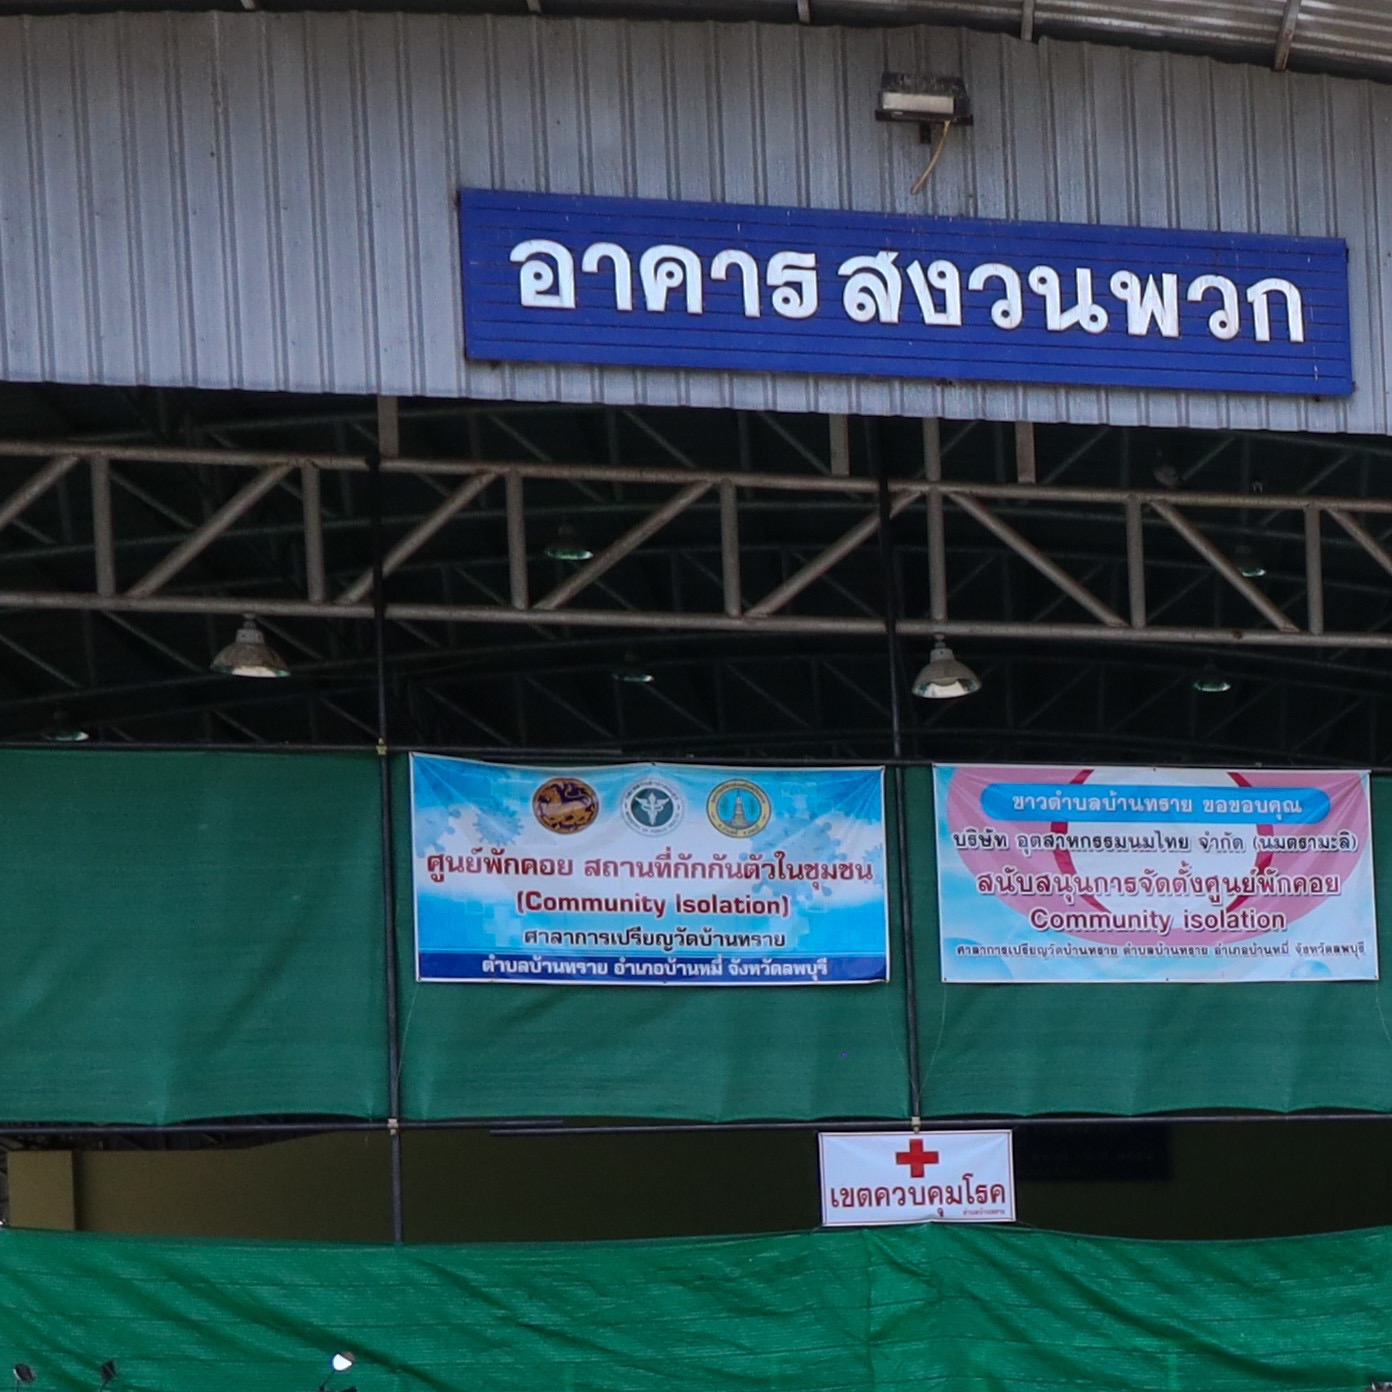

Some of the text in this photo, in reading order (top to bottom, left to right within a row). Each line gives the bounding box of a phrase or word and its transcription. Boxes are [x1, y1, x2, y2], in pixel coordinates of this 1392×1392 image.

[508, 237, 1306, 344] อาคาร สงวนพวก
[1202, 795, 1303, 820] ขอขอบคุณ
[953, 829, 1008, 850] บริษัท
[1017, 830, 1189, 857] อุตสาหกรรมนมไทย
[1197, 832, 1244, 852] จำกัด
[426, 846, 874, 891] ศูนย์พักคอย สถานที่กักกันตัวในชุมชน
[976, 862, 1341, 904] สนับสนุนการจัดตั้งศูนย์พักคอย
[516, 890, 791, 918] (Community Isolation)
[1030, 907, 1286, 934] Community isolation
[523, 926, 786, 951] ศาลาการเปรียญวัดบ้านทราย
[481, 955, 609, 975] ตำบลบ้านทราย
[830, 1173, 1006, 1218] เขตควบคุมโรค
